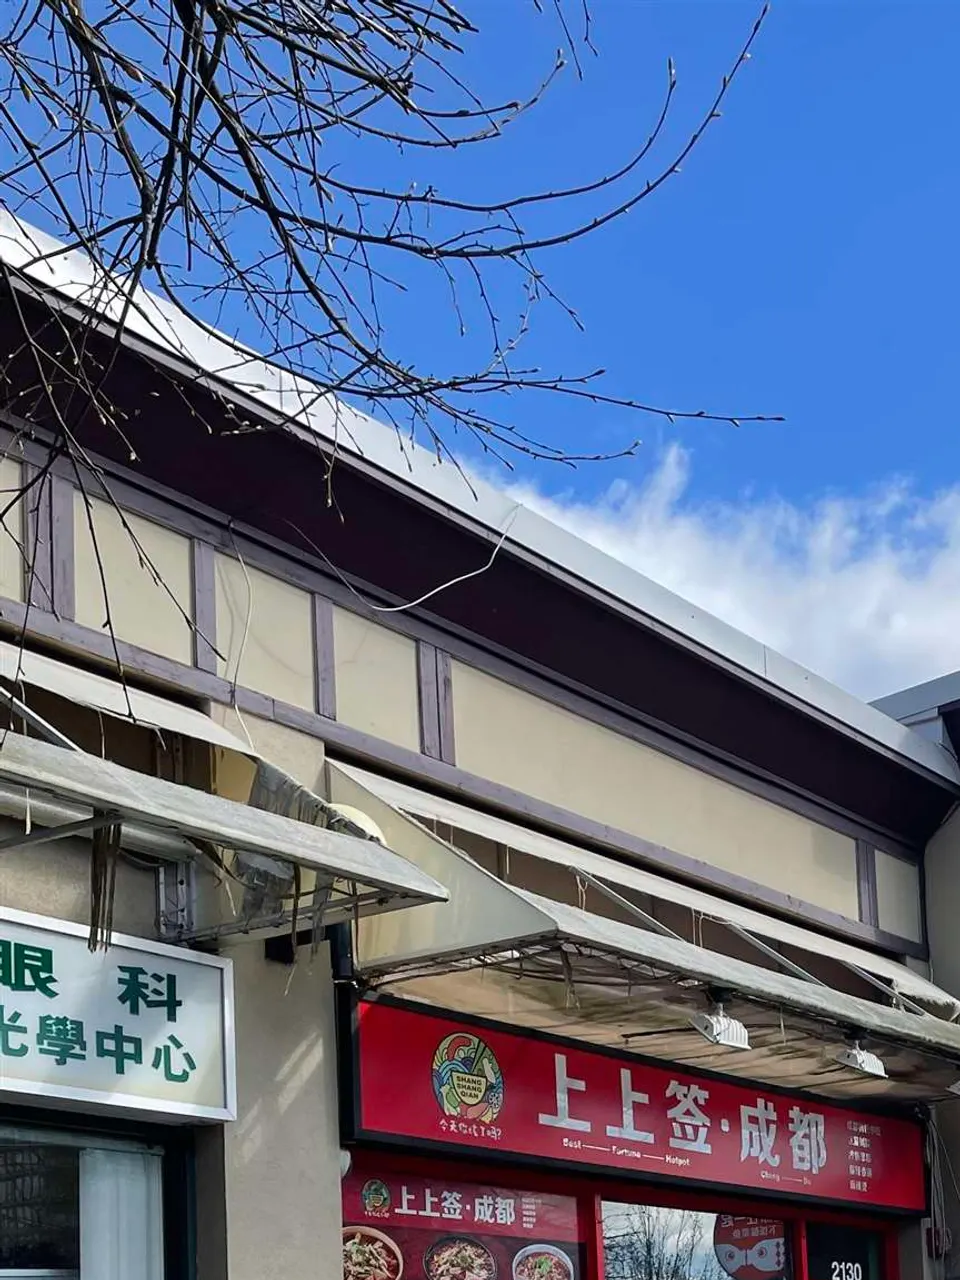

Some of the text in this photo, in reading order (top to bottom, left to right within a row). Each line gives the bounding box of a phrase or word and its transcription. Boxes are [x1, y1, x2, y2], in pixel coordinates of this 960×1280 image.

[456, 1076, 482, 1086] SHANG
[457, 1083, 482, 1093] SHANG
[460, 1091, 479, 1100] QIAN
[665, 1155, 690, 1167] Hotpot
